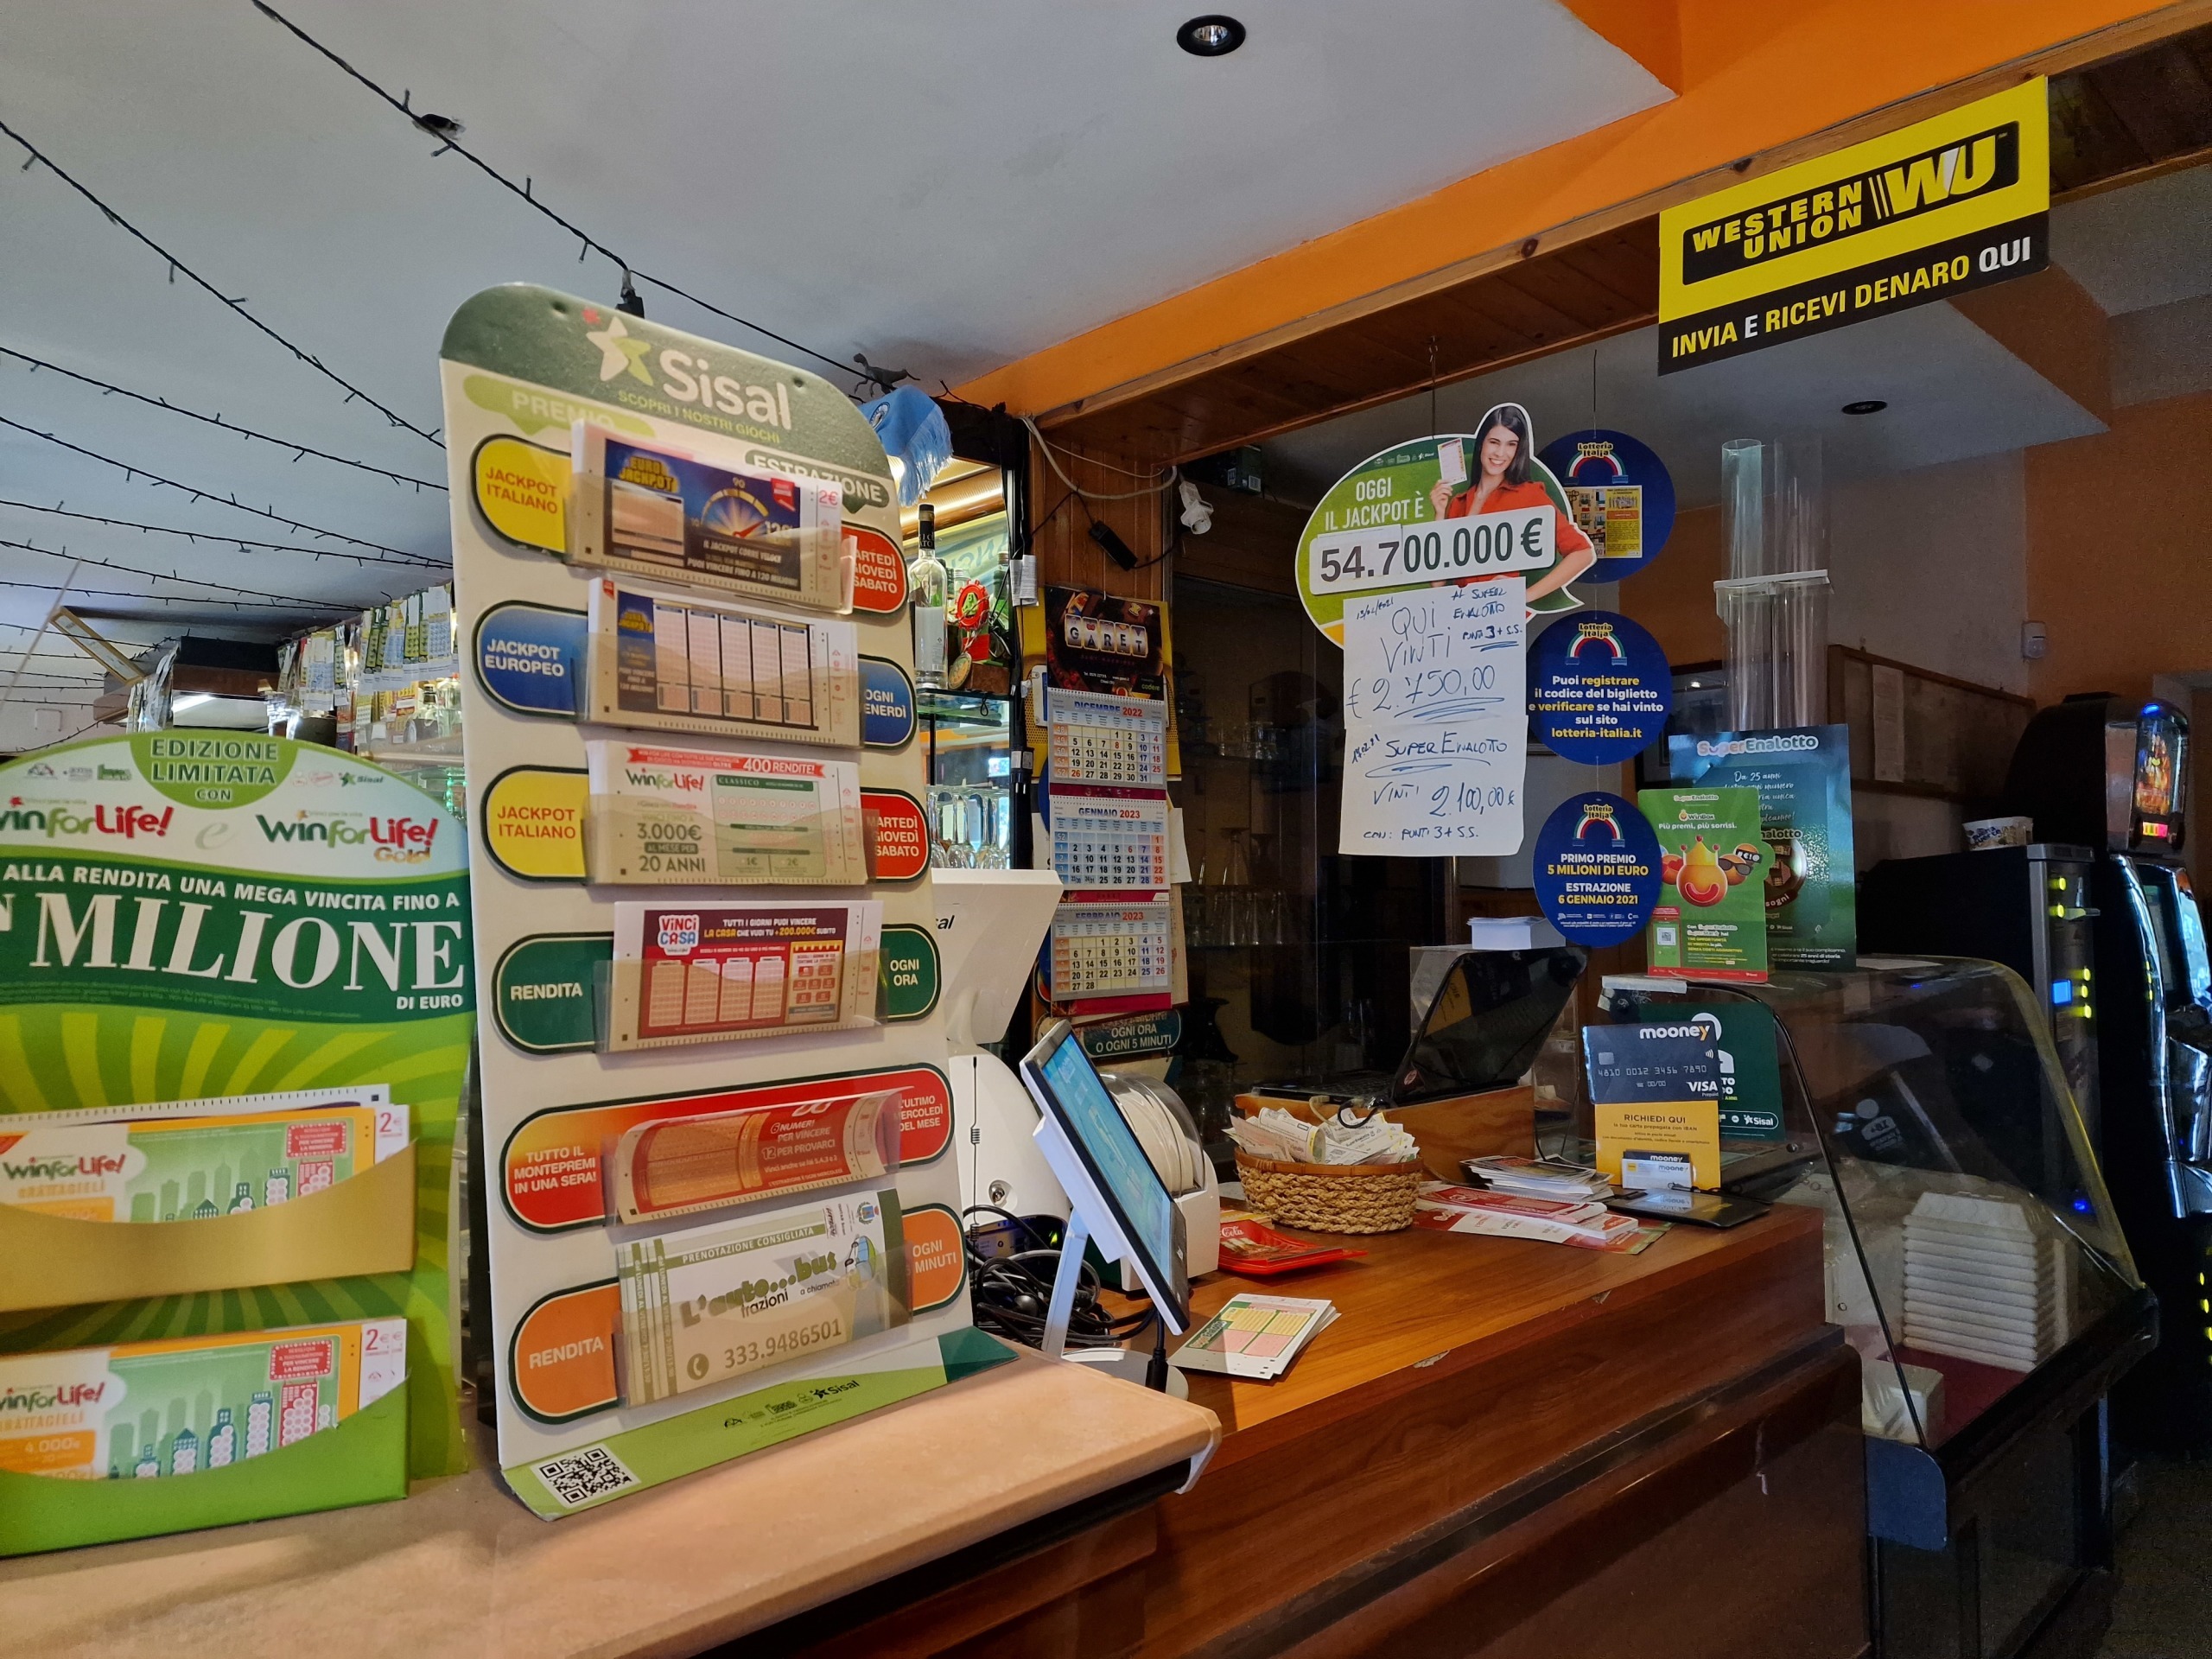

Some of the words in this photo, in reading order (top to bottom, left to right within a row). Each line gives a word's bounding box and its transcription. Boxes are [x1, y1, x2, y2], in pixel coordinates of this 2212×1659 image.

[1884, 133, 1999, 215] WU
[1693, 181, 1863, 253] WESTERN
[1744, 205, 1862, 259] UNION
[1672, 322, 1738, 359] INVIA
[1745, 315, 1758, 339] E
[1764, 290, 1847, 334] RICEVI
[1854, 256, 1970, 309] DENARO
[1979, 237, 2031, 273] QUI
[659, 349, 791, 429] Sisal
[618, 389, 671, 415] SCOPRI
[683, 408, 732, 431] NOSTRI
[735, 420, 780, 445] GIOCHI
[485, 466, 557, 499] JACKPOT
[1356, 477, 1392, 501] OGGI
[486, 484, 557, 515] ITALIANO
[819, 490, 838, 505] 2€
[1325, 512, 1338, 531] IL
[1342, 499, 1410, 530] JACKPOT
[1415, 491, 1424, 518] È
[1320, 521, 1514, 582] 54.700.000
[1521, 518, 1543, 557] €
[1471, 587, 1507, 600] SUPER
[1391, 601, 1435, 641] QUI
[1070, 626, 1142, 652] GARET
[486, 638, 561, 660] JACKPOT
[1381, 626, 1452, 672] VINTI
[484, 654, 565, 677] EUROPEO
[1553, 676, 1579, 684] Puoi
[1582, 676, 1640, 687] registrare
[865, 689, 893, 703] OGNI
[1535, 688, 1541, 698] il
[1545, 689, 1583, 698] codice
[1586, 689, 1605, 698] del
[1607, 689, 1657, 700] biglietto
[1123, 707, 1143, 717] 2022
[1538, 701, 1594, 711] verificare
[1613, 702, 1630, 711] hai
[1633, 702, 1663, 711] vinto
[1575, 715, 1592, 724] sul
[1596, 715, 1618, 724] sito
[1552, 728, 1642, 738] lotteria-italia.it
[150, 737, 279, 760] EDIZIONE
[1071, 747, 1080, 757] 12
[1698, 736, 1818, 757] SuperEnalotto
[151, 763, 276, 785] LIMITATA
[742, 759, 772, 774] 400
[772, 761, 816, 776] RENDITE!
[718, 777, 760, 787] CLASSICO
[1750, 772, 1761, 781] 25
[194, 788, 232, 802] CON
[1374, 781, 1419, 804] VINTI
[497, 804, 575, 822] JACKPOT
[1078, 807, 1117, 817] GENNAIO
[1120, 810, 1141, 819] 2023
[499, 823, 576, 840] ITALIANO
[638, 823, 702, 842] 3.000€
[373, 847, 432, 864] Gold
[639, 855, 664, 873] 20
[666, 856, 706, 873] ANNI
[1560, 854, 1594, 863] PRIMO
[1597, 855, 1636, 863] PREMIO
[1548, 865, 1554, 875] 5
[1557, 865, 1600, 875] MILIONI
[1604, 865, 1615, 875] DI
[1618, 865, 1649, 876] EURO
[3, 864, 64, 883] ALLA
[73, 866, 172, 892] RENDITA
[179, 877, 226, 898] UNA
[233, 885, 297, 906] MEGA
[305, 891, 386, 912] VINCITA
[393, 893, 440, 911] FINO
[445, 892, 460, 907] A
[1566, 882, 1631, 893] ESTRAZIONE
[1558, 895, 1564, 904] 6
[1567, 895, 1614, 905] GENNAIO
[1617, 895, 1638, 904] 2021
[750, 918, 772, 926] GIORNI
[29, 893, 465, 992] MILIONE
[660, 931, 696, 945] CASA
[890, 959, 919, 971] OGNI
[893, 974, 918, 986] ORA
[510, 982, 584, 1001] RENDITA
[396, 995, 416, 1011] DI
[420, 994, 464, 1010] EURO
[1111, 1027, 1138, 1038] OGNI
[1140, 1025, 1157, 1035] ORA
[1640, 1025, 1710, 1040] mooney
[1105, 1040, 1130, 1052] OGNI
[1141, 1035, 1172, 1047] MINUTI
[1599, 1066, 1620, 1077] 4810
[1655, 1066, 1677, 1075] 3456
[1684, 1065, 1707, 1073] 7890
[1687, 1081, 1718, 1092] VISA
[918, 1118, 941, 1129] MESE
[794, 1127, 831, 1140] VINCERE
[525, 1147, 569, 1163] TUTTO
[572, 1146, 585, 1159] IL
[761, 1147, 776, 1160] 12
[777, 1145, 791, 1158] PER
[792, 1139, 836, 1155] PROVARCI
[513, 1158, 596, 1179] MONTEPREMI
[515, 1180, 529, 1194] IN
[531, 1177, 558, 1192] UNA
[560, 1171, 597, 1188] SERA!
[682, 1240, 755, 1264] PRENOTAZIONE
[757, 1227, 815, 1248] CONSIGLIATA
[912, 1240, 944, 1258] OGNI
[915, 1251, 957, 1273] MINUTI
[741, 1288, 788, 1319] frazioni
[529, 1336, 604, 1370] RENDITA
[724, 1319, 842, 1370] 333.9486501
[828, 1380, 860, 1395] Sisal
